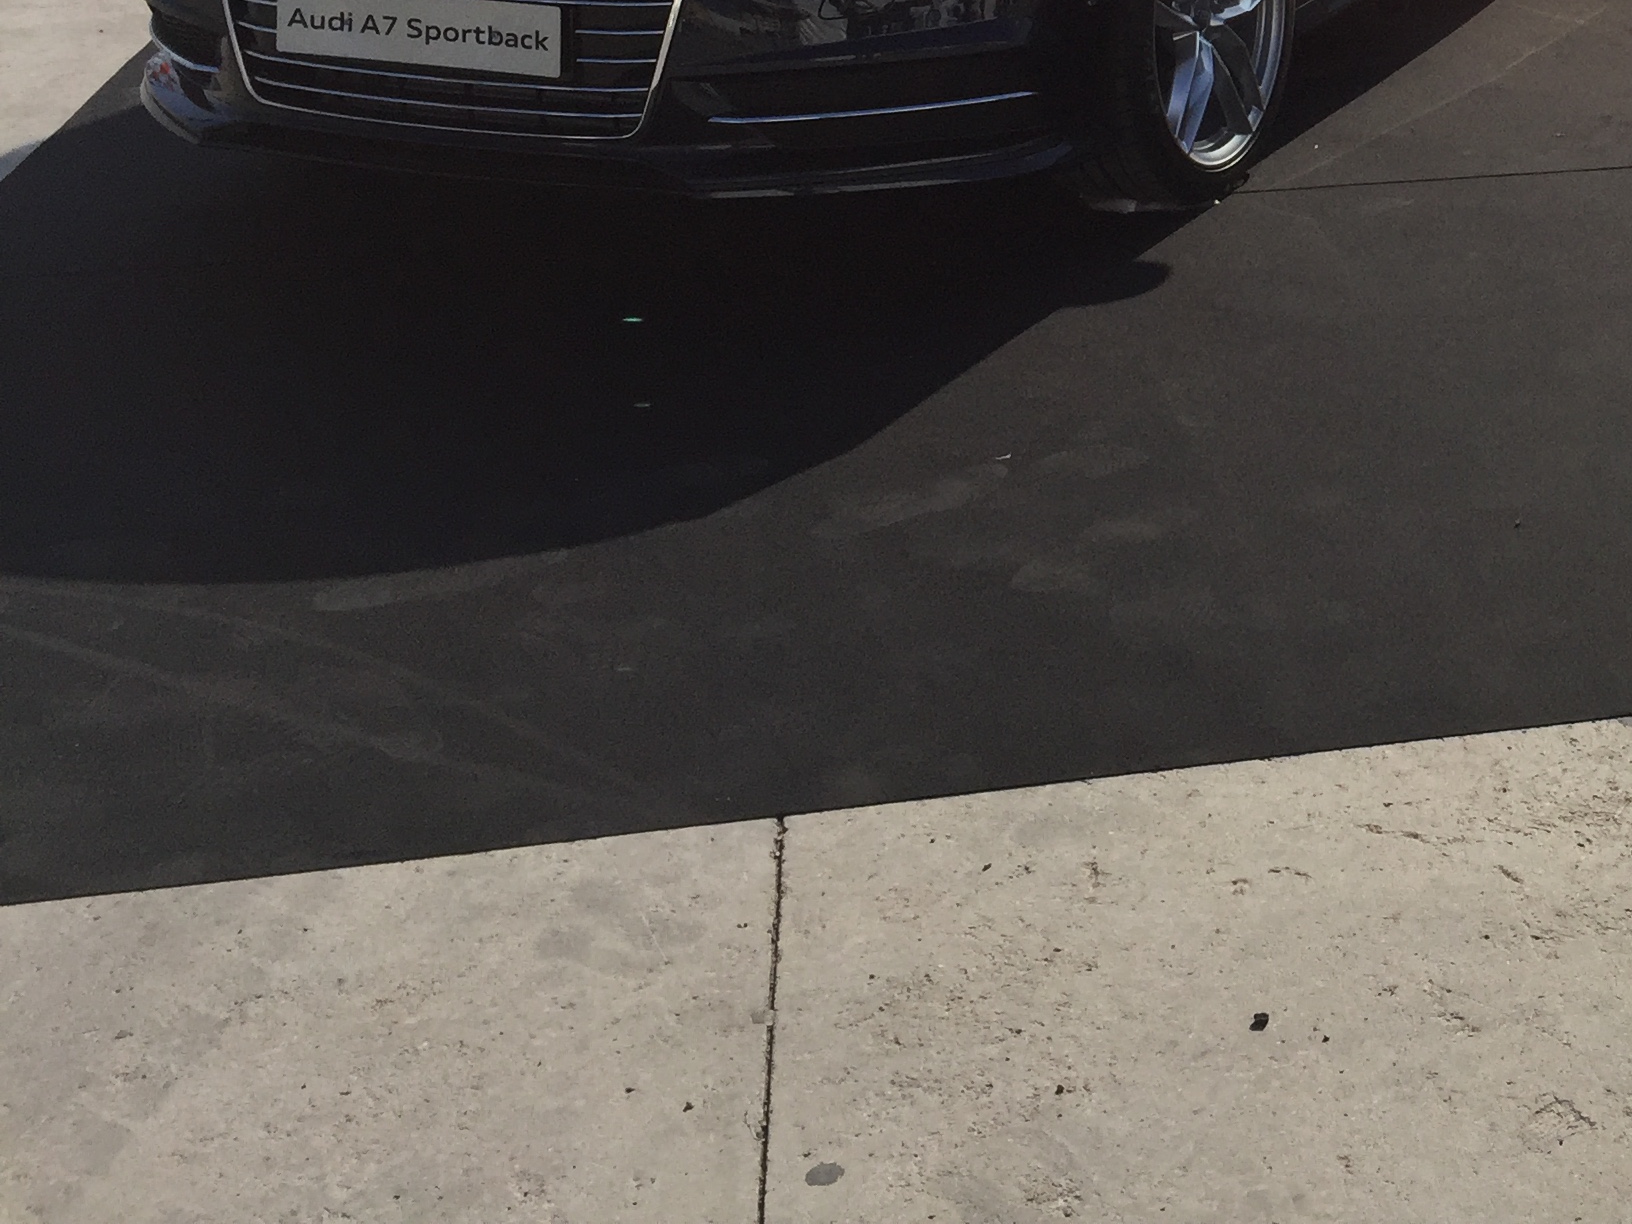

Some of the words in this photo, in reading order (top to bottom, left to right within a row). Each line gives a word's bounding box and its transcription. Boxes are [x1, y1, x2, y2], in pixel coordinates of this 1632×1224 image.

[287, 7, 353, 33] Audi
[360, 14, 397, 36] A7
[406, 18, 549, 51] Sportback
